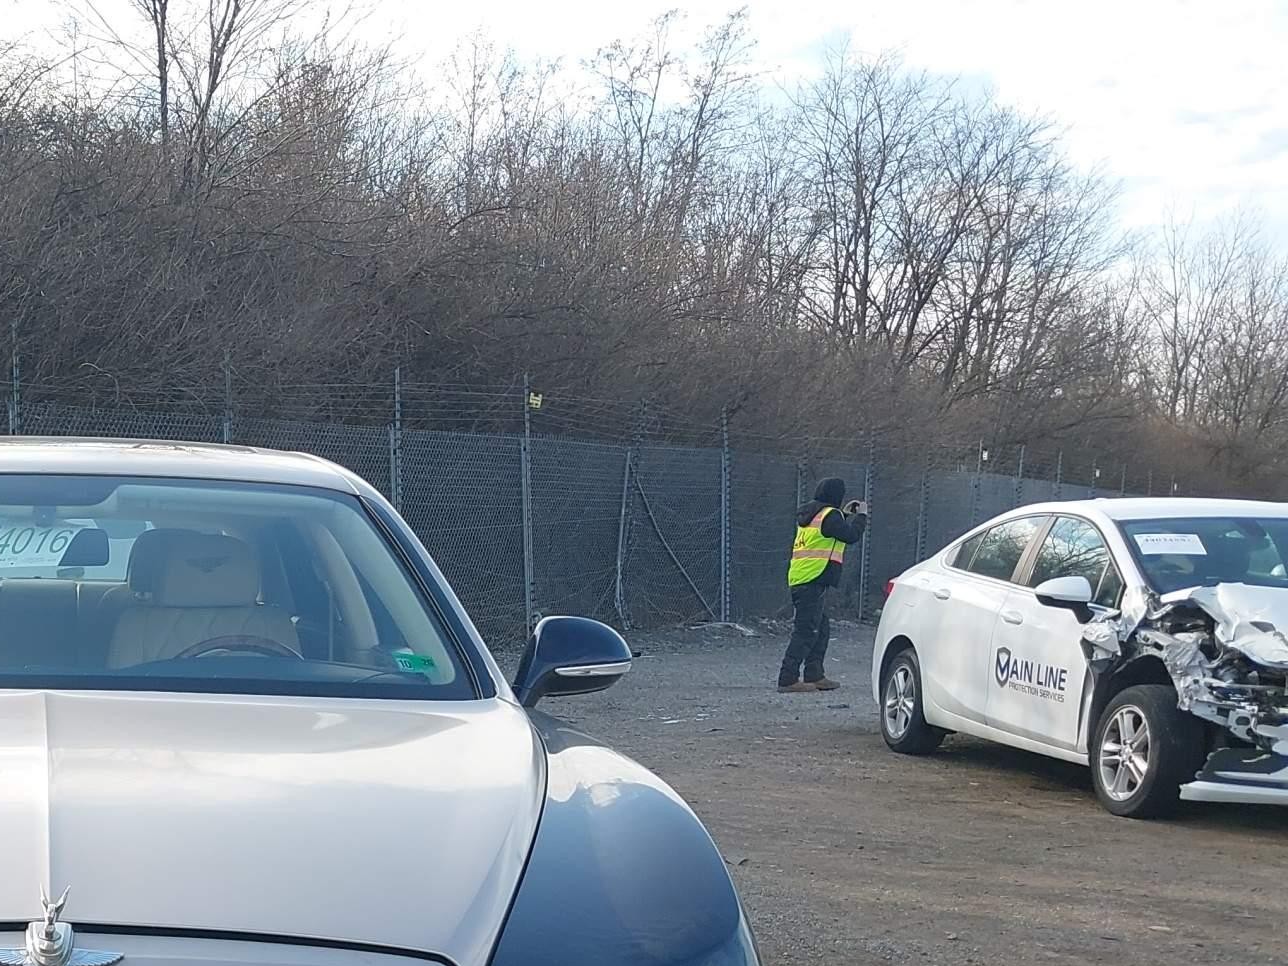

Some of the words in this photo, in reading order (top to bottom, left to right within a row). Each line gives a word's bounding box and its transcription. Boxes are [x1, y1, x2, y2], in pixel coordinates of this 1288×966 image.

[1036, 663, 1067, 691] LINE
[1008, 681, 1039, 697] PROTECTION
[1039, 689, 1065, 703] SERVICES
